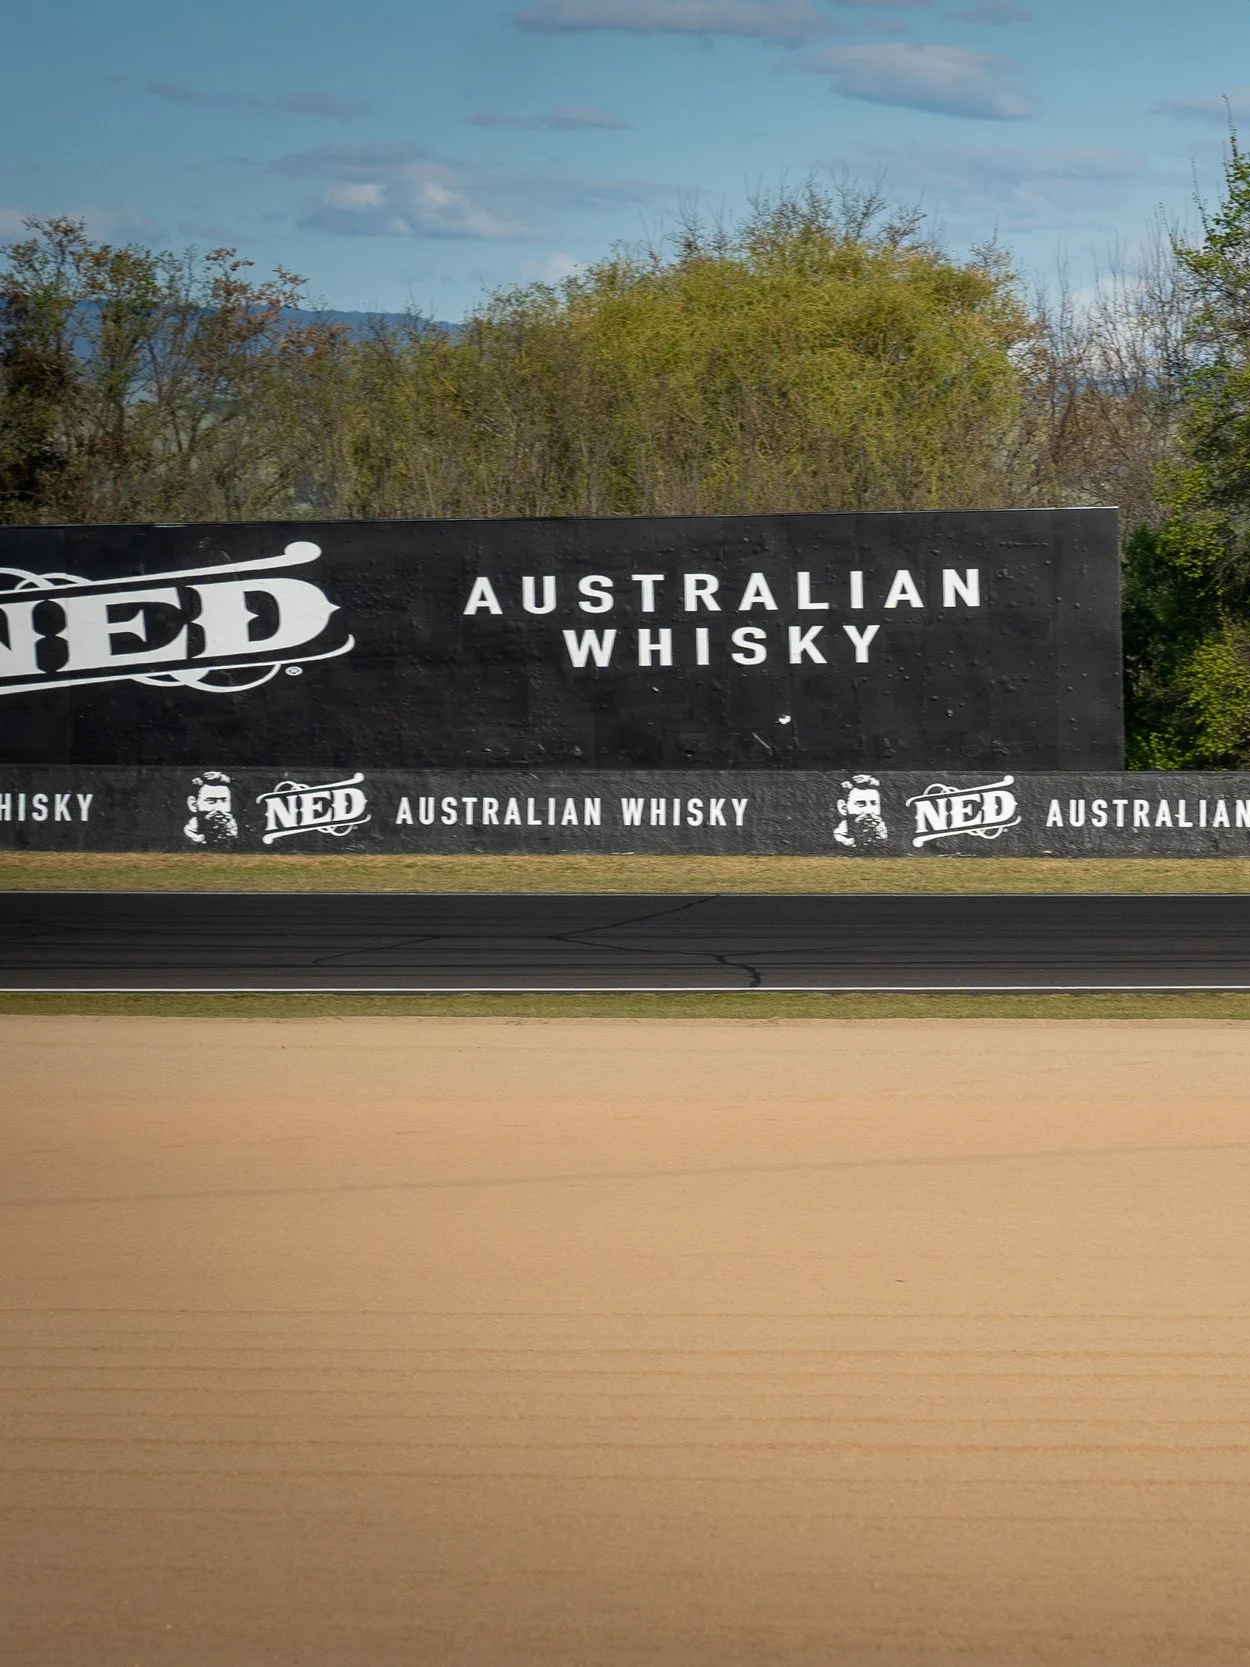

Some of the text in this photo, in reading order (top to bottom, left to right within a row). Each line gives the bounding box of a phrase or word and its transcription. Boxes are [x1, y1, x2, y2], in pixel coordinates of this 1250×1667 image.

[463, 568, 980, 615] AUSTRALIAN
[0, 577, 341, 678] ED
[562, 624, 880, 668] WHISKY
[0, 793, 93, 822] HISKY
[264, 787, 369, 834] NED
[395, 796, 749, 827] AUSTRALIAN WHISKY
[914, 793, 1019, 839] NED
